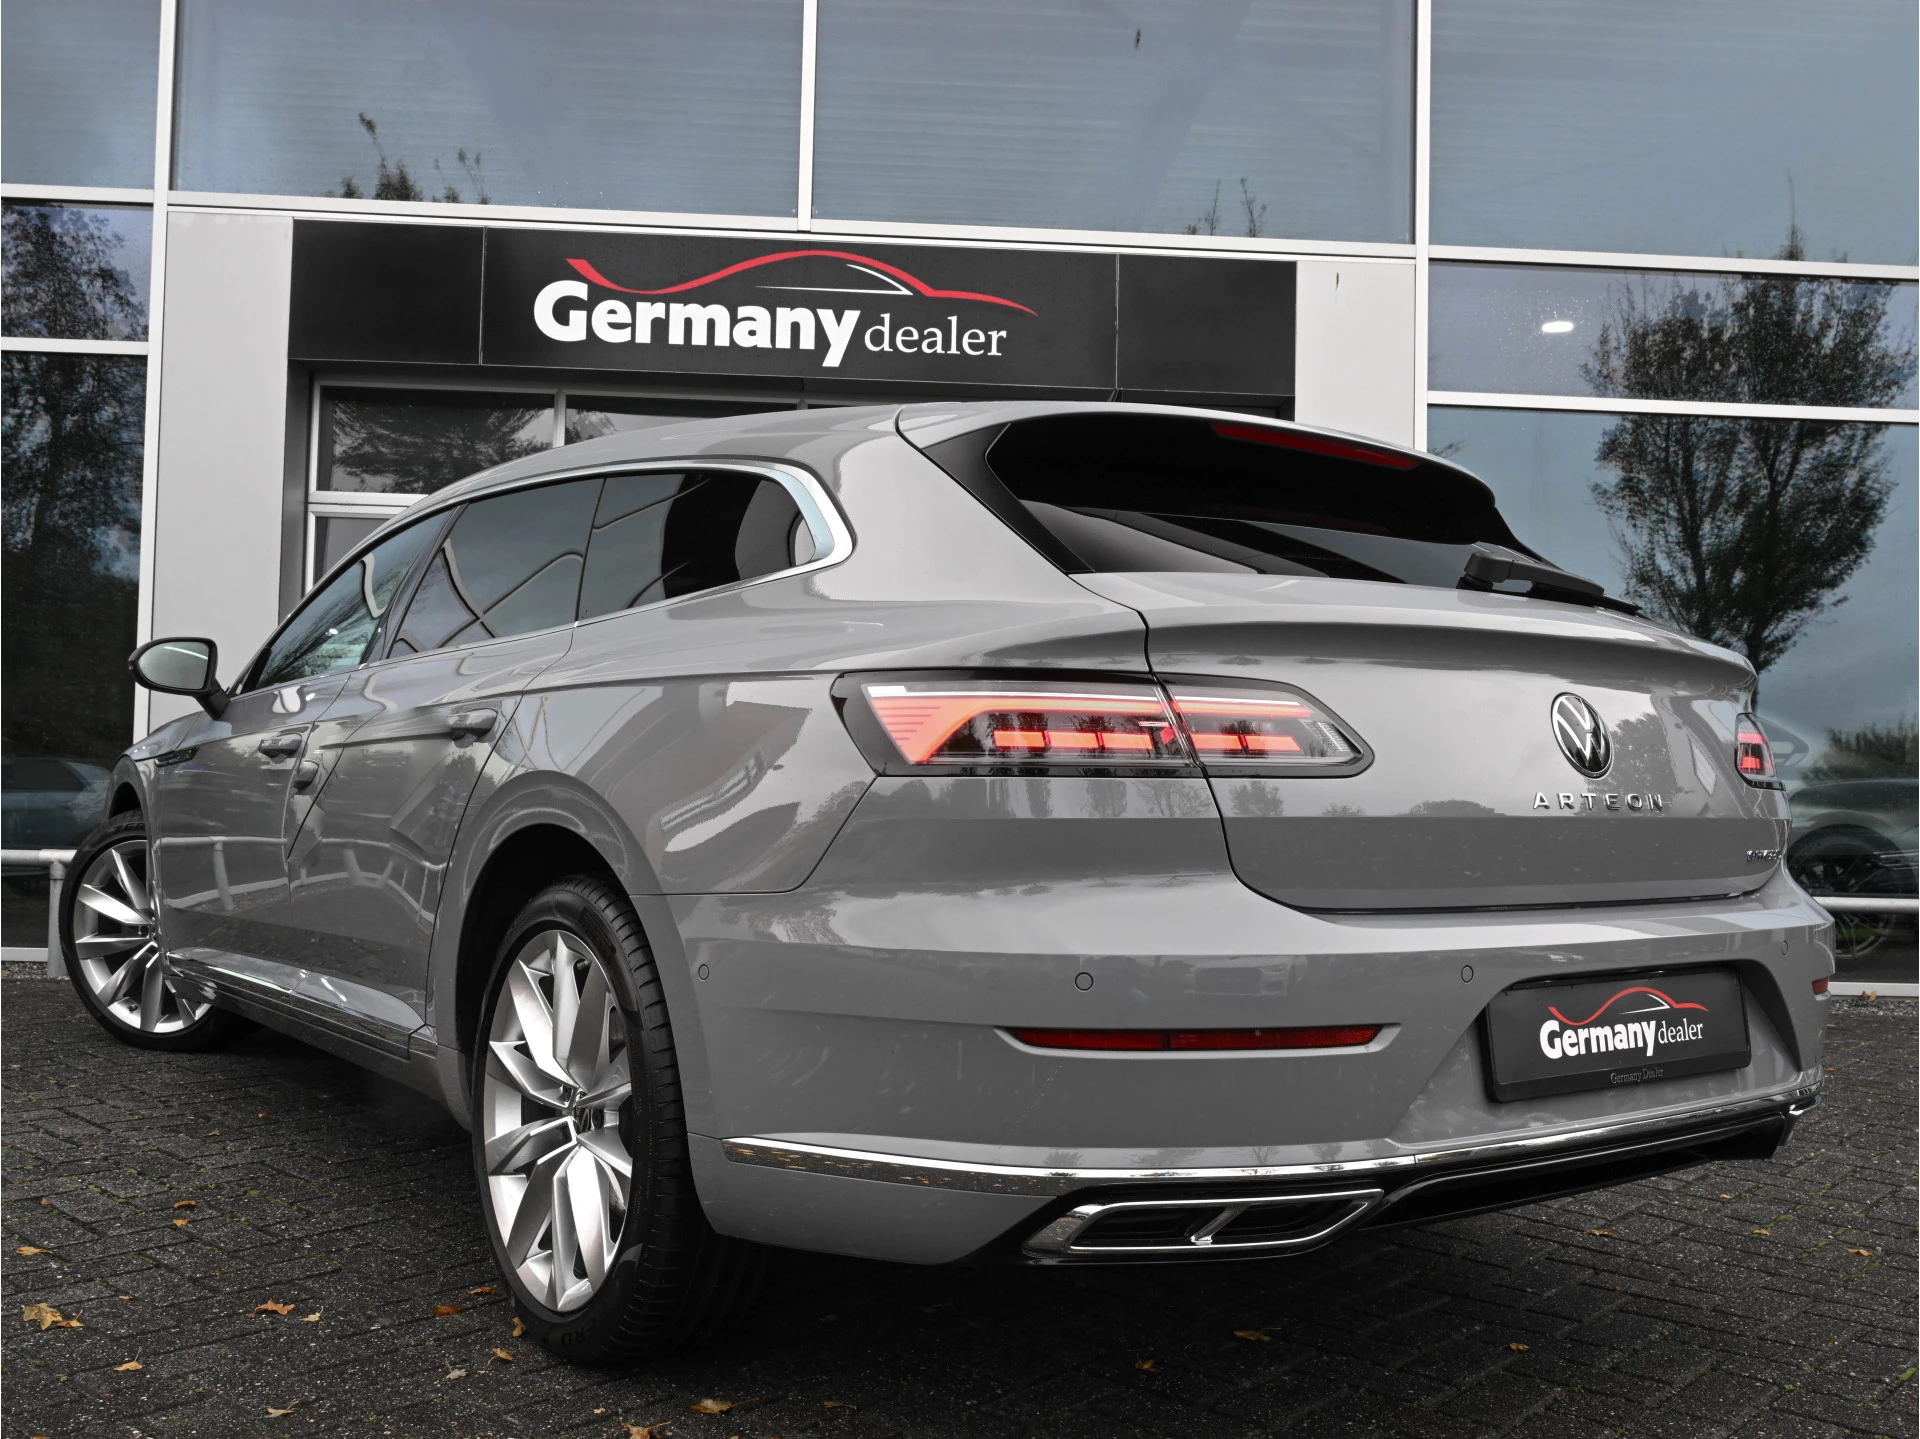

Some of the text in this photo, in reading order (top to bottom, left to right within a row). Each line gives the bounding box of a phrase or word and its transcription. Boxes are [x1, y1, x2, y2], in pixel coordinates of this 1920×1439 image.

[534, 279, 1007, 368] Germany dealer
[1533, 791, 1664, 811] ARTEON
[1539, 1017, 1704, 1060] Germany dealer
[1610, 1067, 1664, 1084] Germany Dealer
